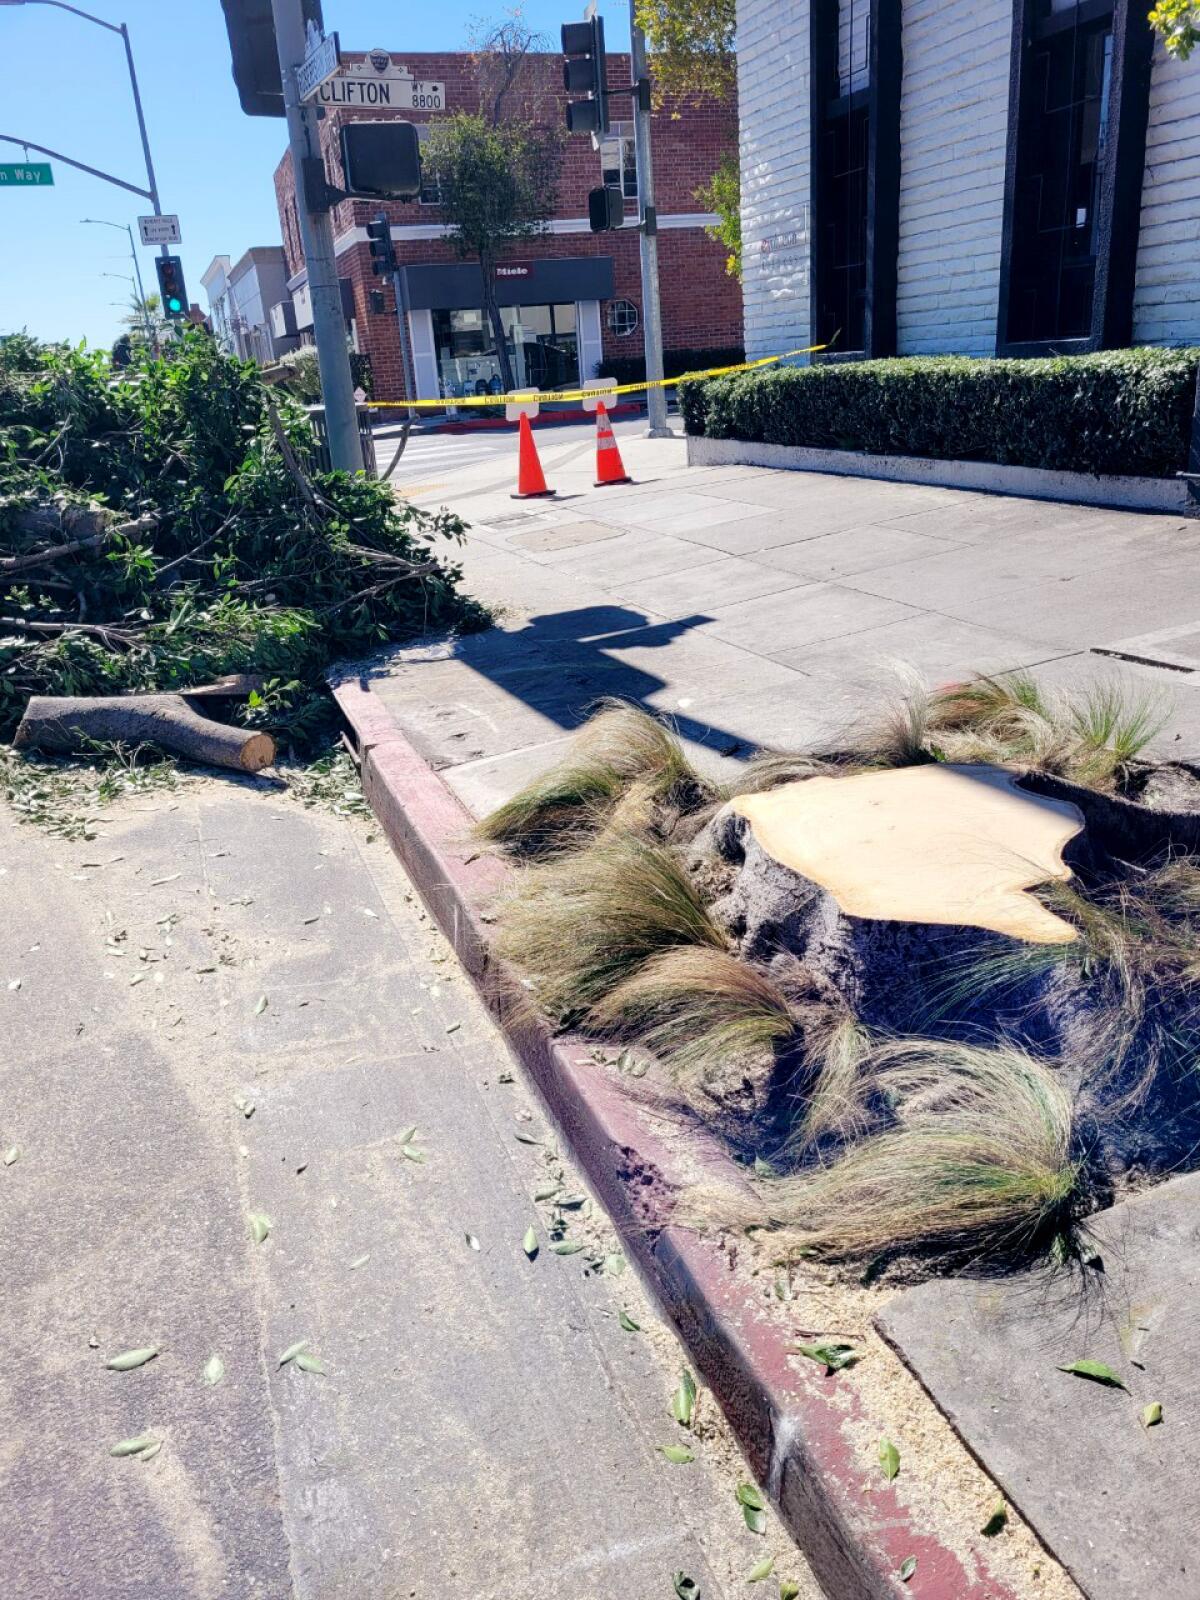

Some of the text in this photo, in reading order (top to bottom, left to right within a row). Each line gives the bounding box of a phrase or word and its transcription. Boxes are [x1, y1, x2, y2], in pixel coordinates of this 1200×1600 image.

[319, 81, 424, 104] CLIFTON WY
[411, 94, 441, 109] 8800
[14, 168, 41, 184] Way
[496, 267, 528, 276] Miele
